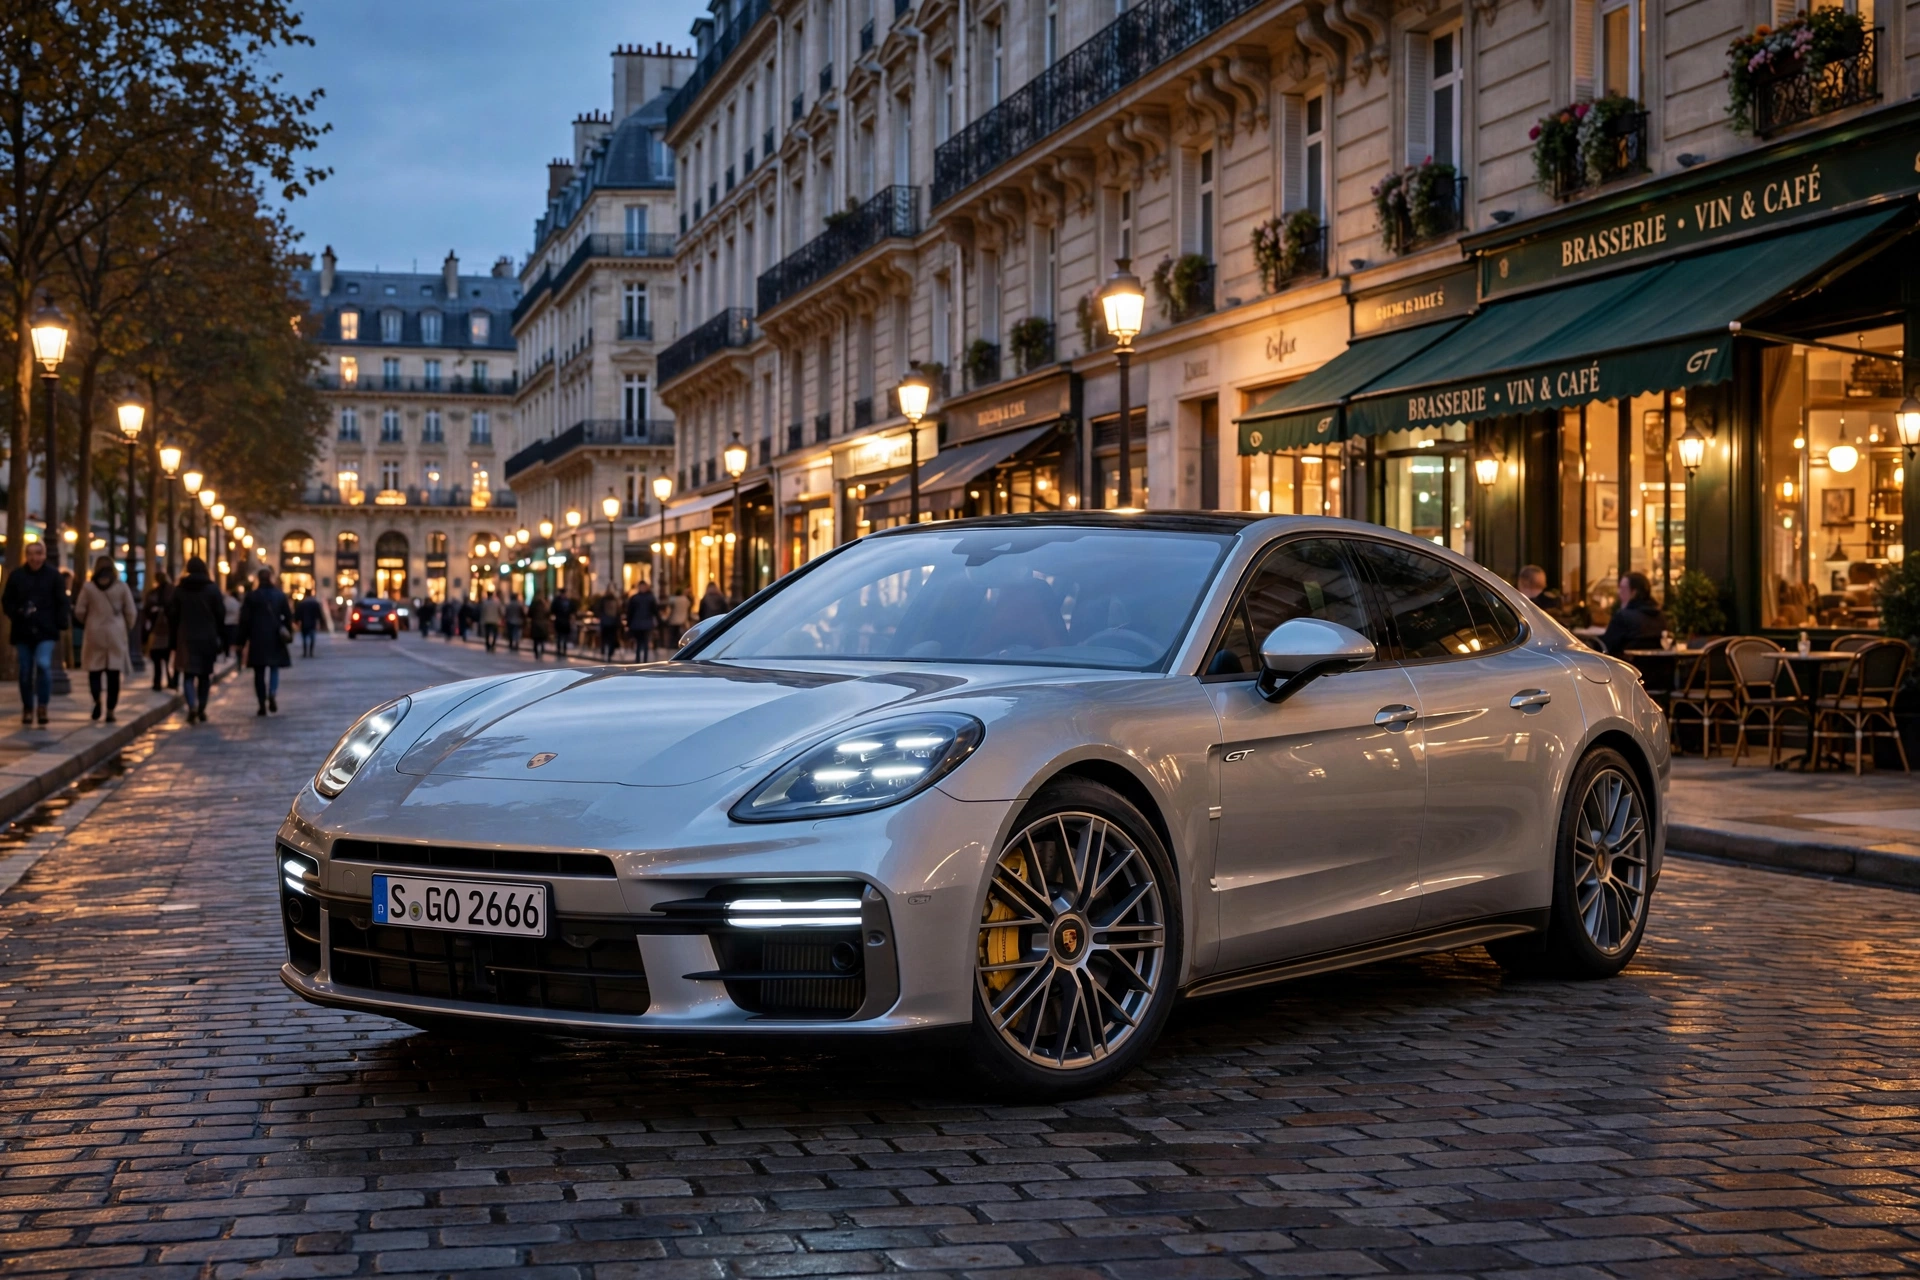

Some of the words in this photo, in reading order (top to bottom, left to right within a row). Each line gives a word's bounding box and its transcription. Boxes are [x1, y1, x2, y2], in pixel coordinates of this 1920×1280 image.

[1561, 214, 1667, 267] BRASSERIE
[1694, 196, 1732, 231] VIN
[1740, 190, 1755, 220] &
[1763, 163, 1821, 214] CAFÉ
[1686, 348, 1718, 374] GT
[1408, 386, 1487, 422] BRASSERIE
[1506, 378, 1535, 406] VIN
[1539, 376, 1552, 401] &
[1557, 360, 1600, 397] CAFÉ
[1224, 749, 1255, 763] GT
[390, 884, 406, 918] S
[426, 886, 461, 924] GO
[468, 890, 539, 929] 2666
